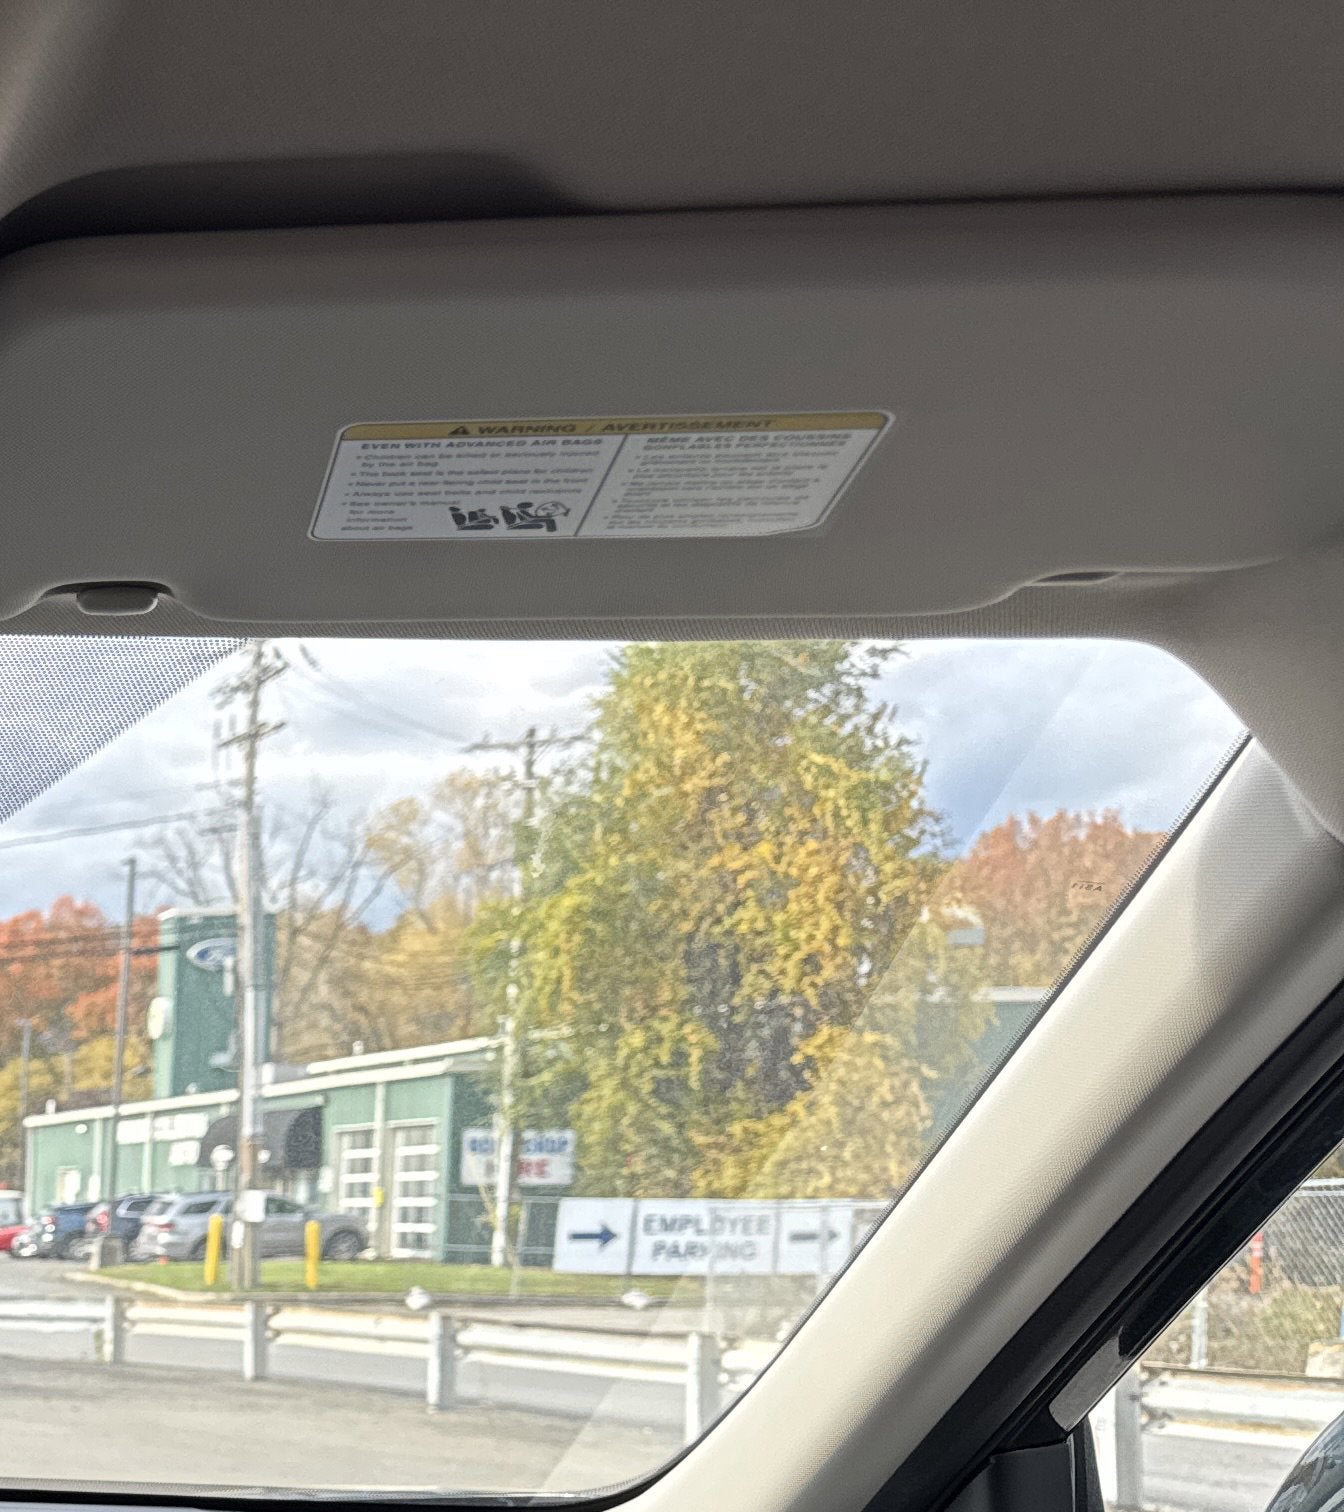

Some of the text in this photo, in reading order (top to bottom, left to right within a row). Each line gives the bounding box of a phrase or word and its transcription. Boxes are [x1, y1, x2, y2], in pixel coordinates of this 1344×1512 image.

[477, 423, 576, 434] WARNING
[445, 440, 525, 448] ADVANCED
[643, 1214, 771, 1236] EMPLOYEE
